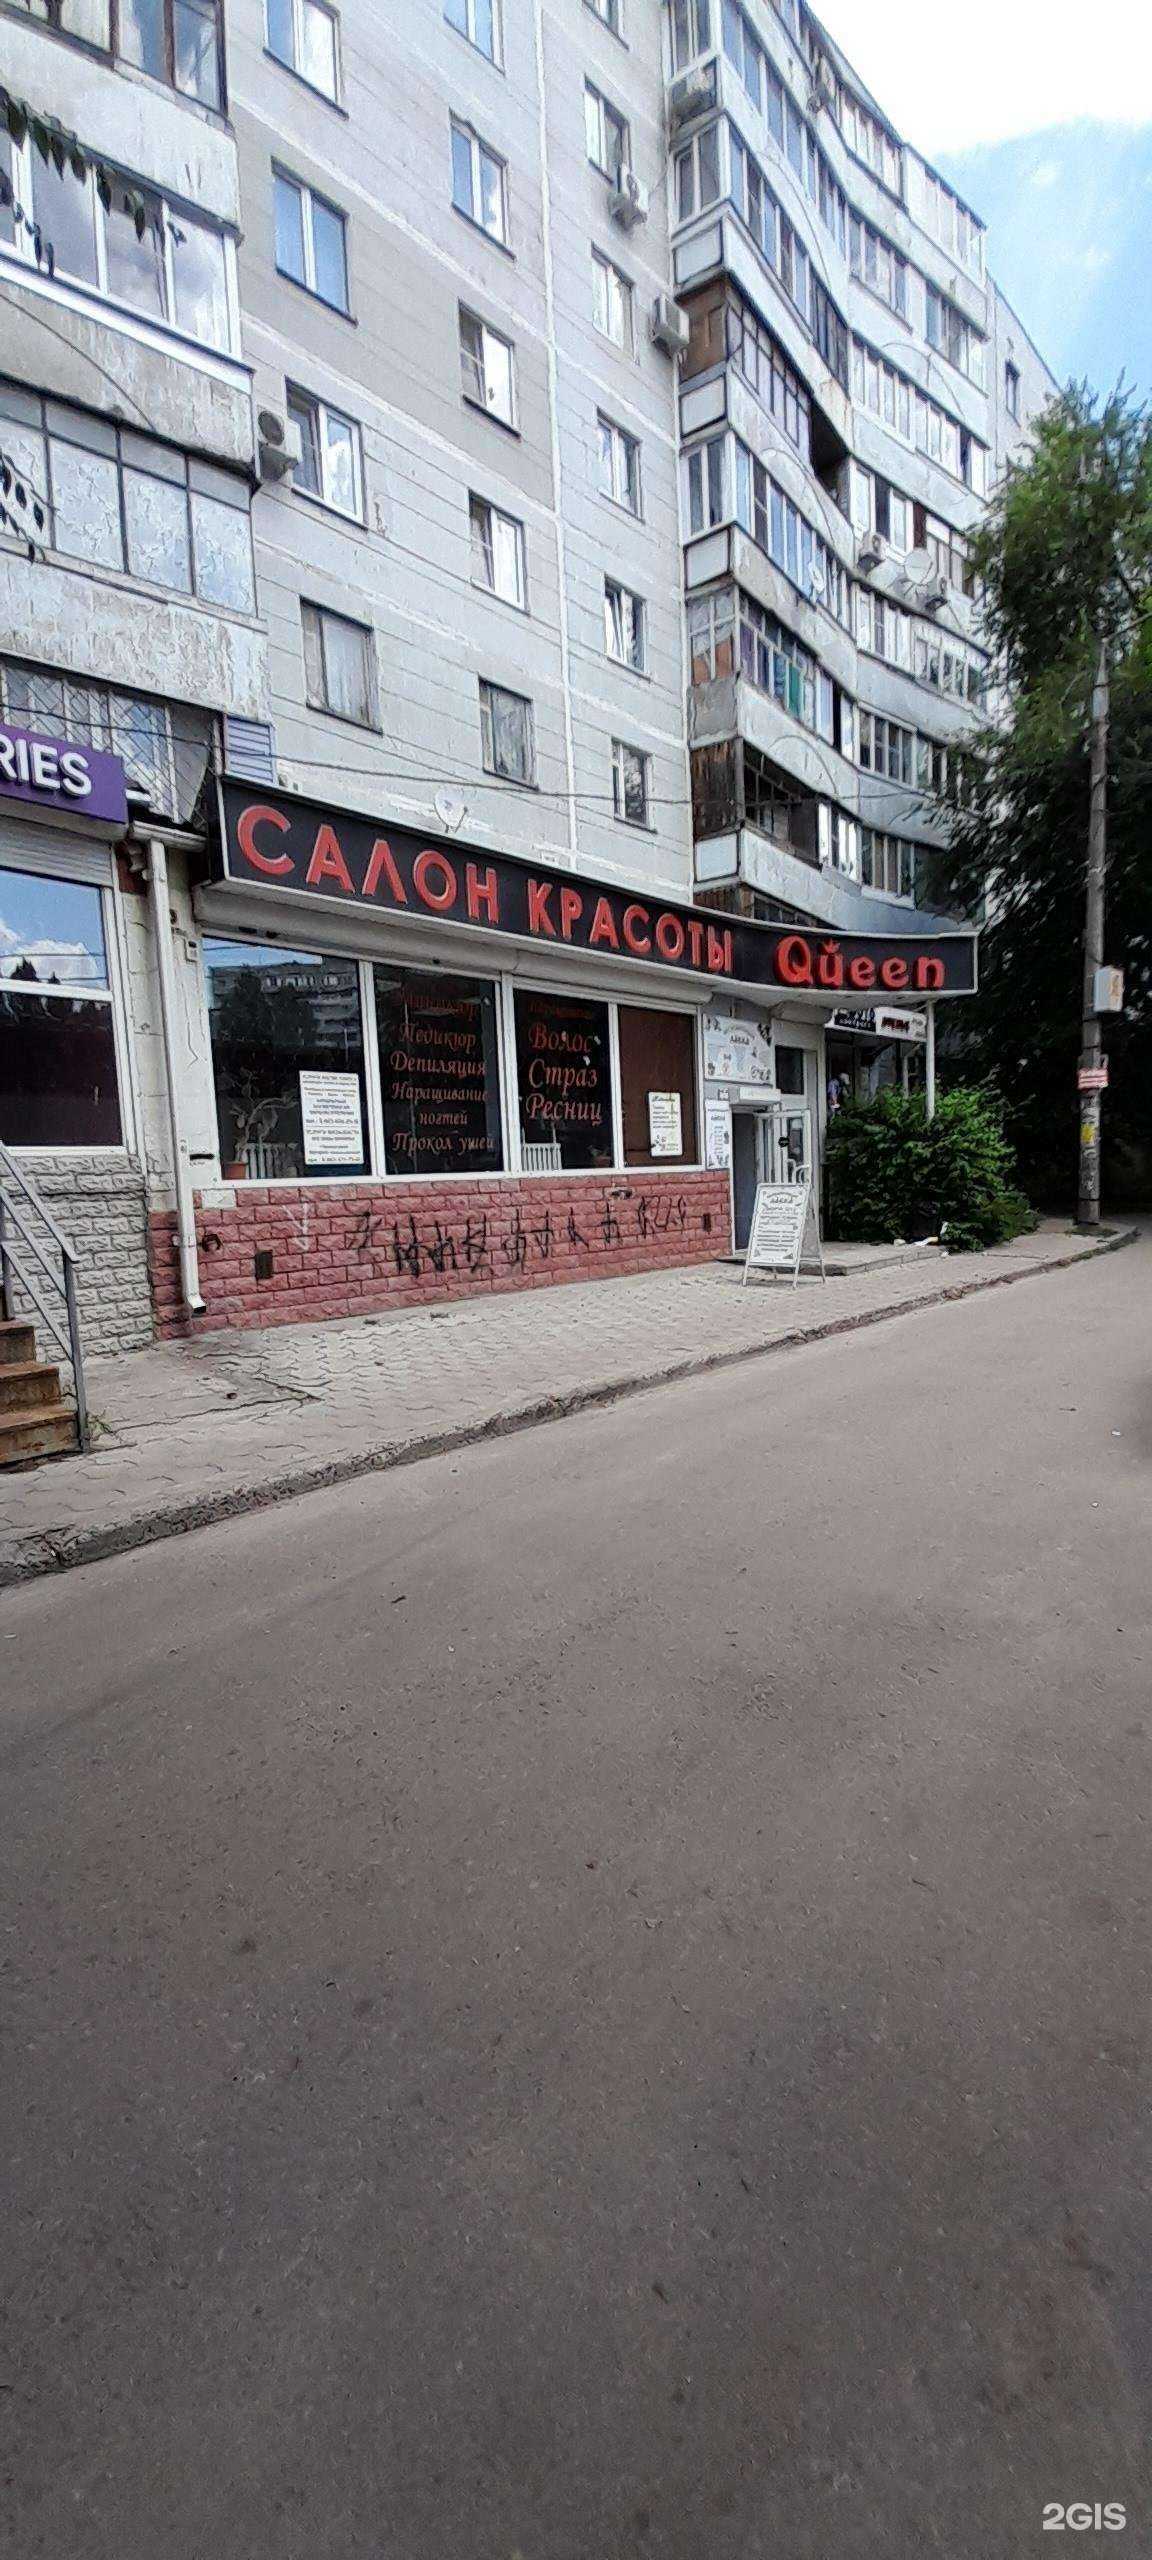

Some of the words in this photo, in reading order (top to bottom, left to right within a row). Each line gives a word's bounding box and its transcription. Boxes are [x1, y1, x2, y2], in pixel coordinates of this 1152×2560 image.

[236, 804, 500, 925] САЛОН
[527, 878, 734, 975] КРАСОТЫ
[773, 934, 946, 990] Queen
[399, 1023, 477, 1056] Педикюр
[527, 1021, 593, 1053] Волос
[389, 1050, 488, 1079] Депиляция
[528, 1058, 598, 1097] Страз
[391, 1081, 488, 1105] Наращивание
[419, 1109, 468, 1126] ногтей
[525, 1092, 602, 1127] Ресниц
[392, 1132, 452, 1158] Прокол
[457, 1133, 495, 1156] ушей
